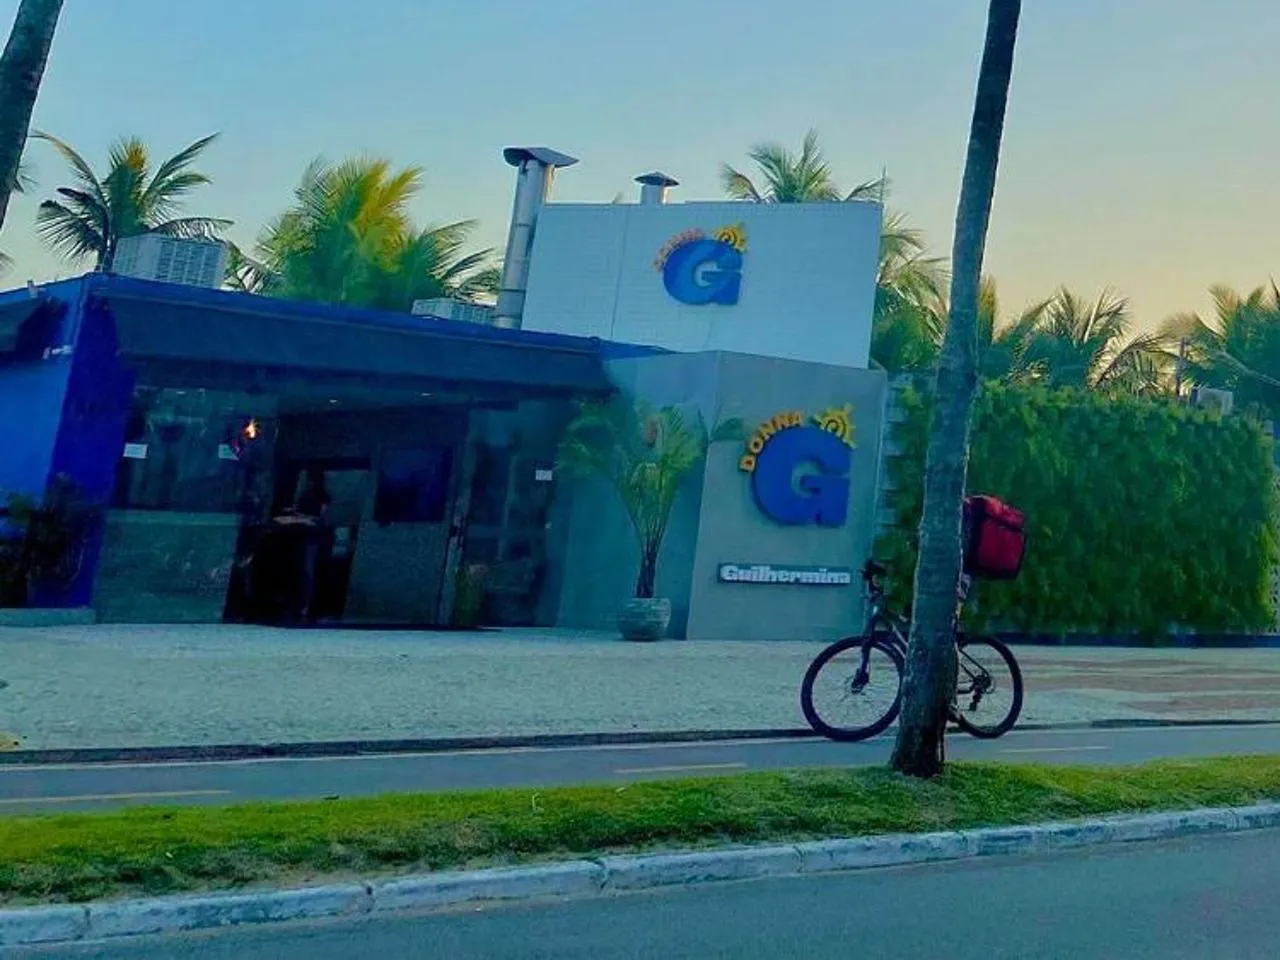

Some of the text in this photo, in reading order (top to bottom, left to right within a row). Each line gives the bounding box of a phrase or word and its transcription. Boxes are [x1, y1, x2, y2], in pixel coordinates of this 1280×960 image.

[663, 239, 742, 305] G
[739, 410, 802, 472] DONNA
[751, 424, 850, 527] G
